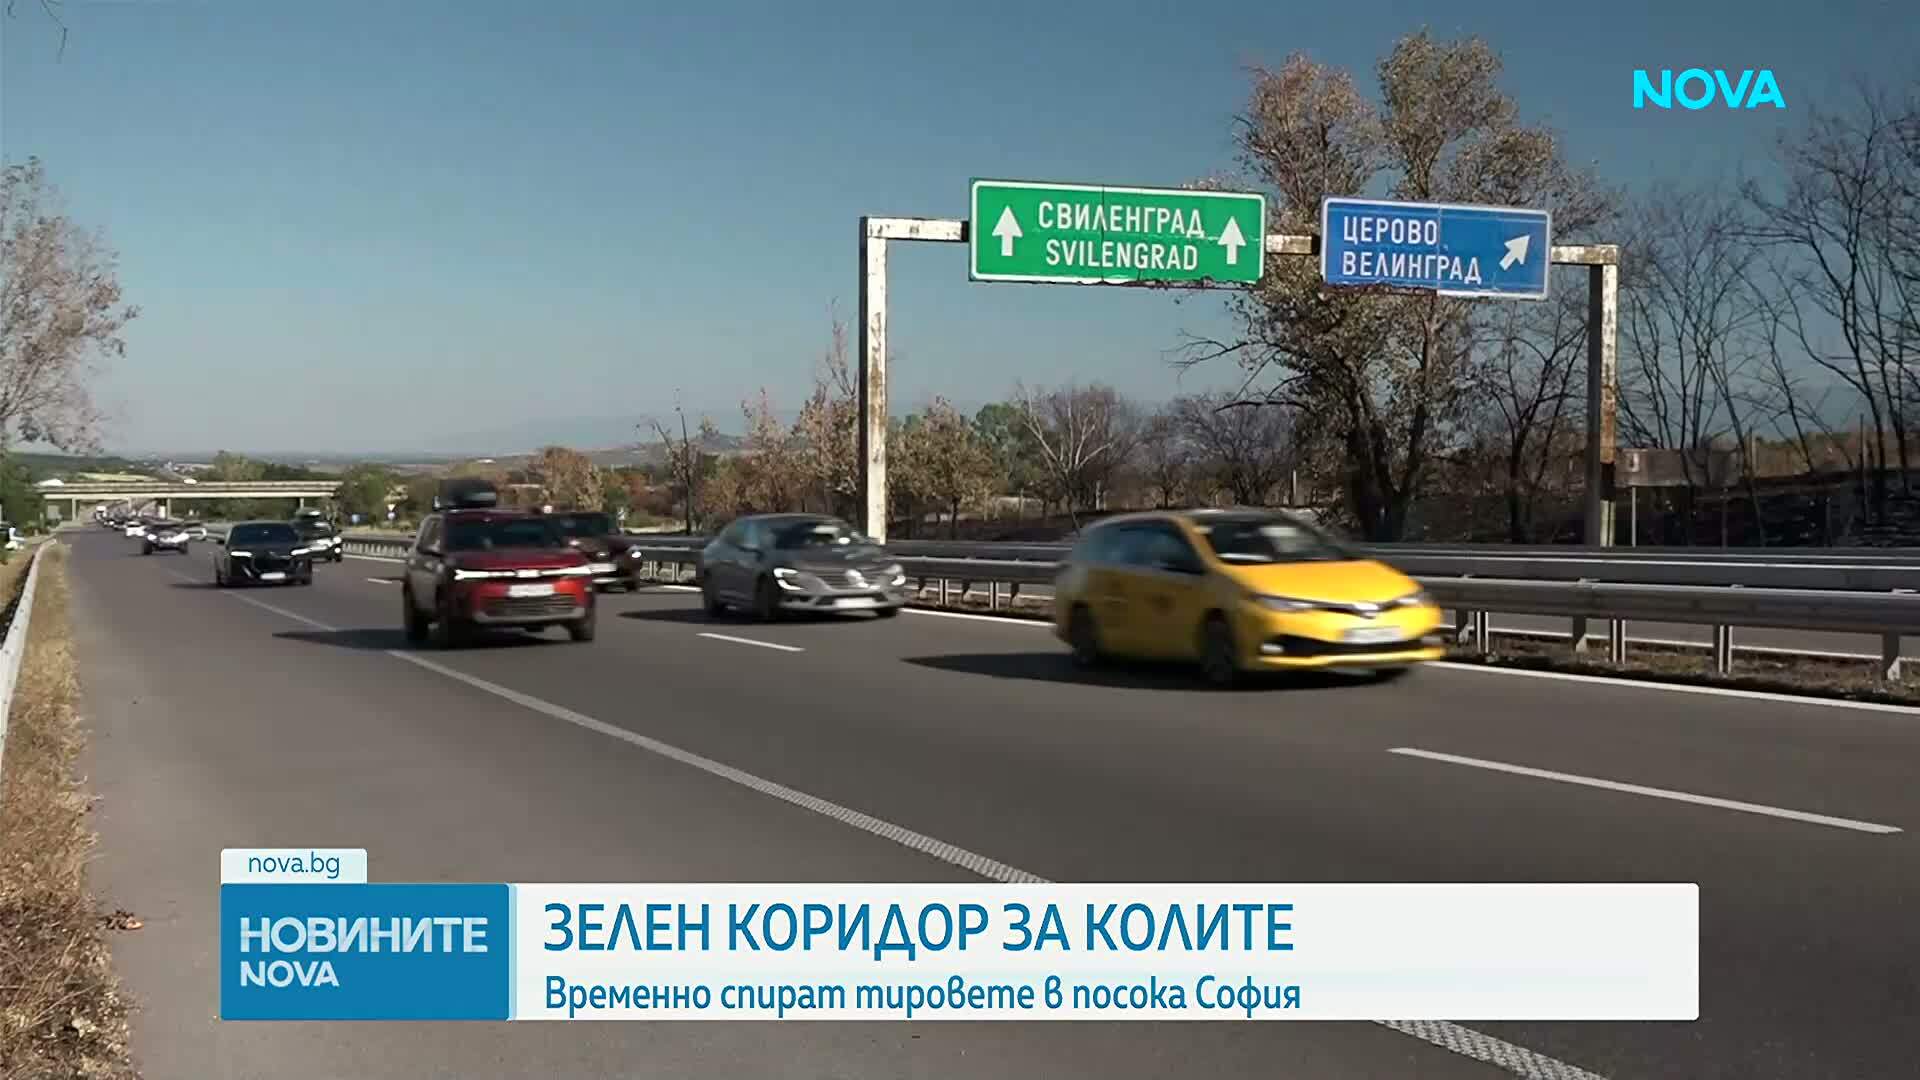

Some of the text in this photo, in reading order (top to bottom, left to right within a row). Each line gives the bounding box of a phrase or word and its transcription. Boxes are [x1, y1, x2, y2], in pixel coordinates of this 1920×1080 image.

[1038, 201, 1205, 238] СВИЛЕНГРАД
[1343, 215, 1438, 246] ЦЕРОВО
[1045, 239, 1198, 271] SVILENGRAD
[1342, 251, 1482, 285] ВЕЛИНГРАД
